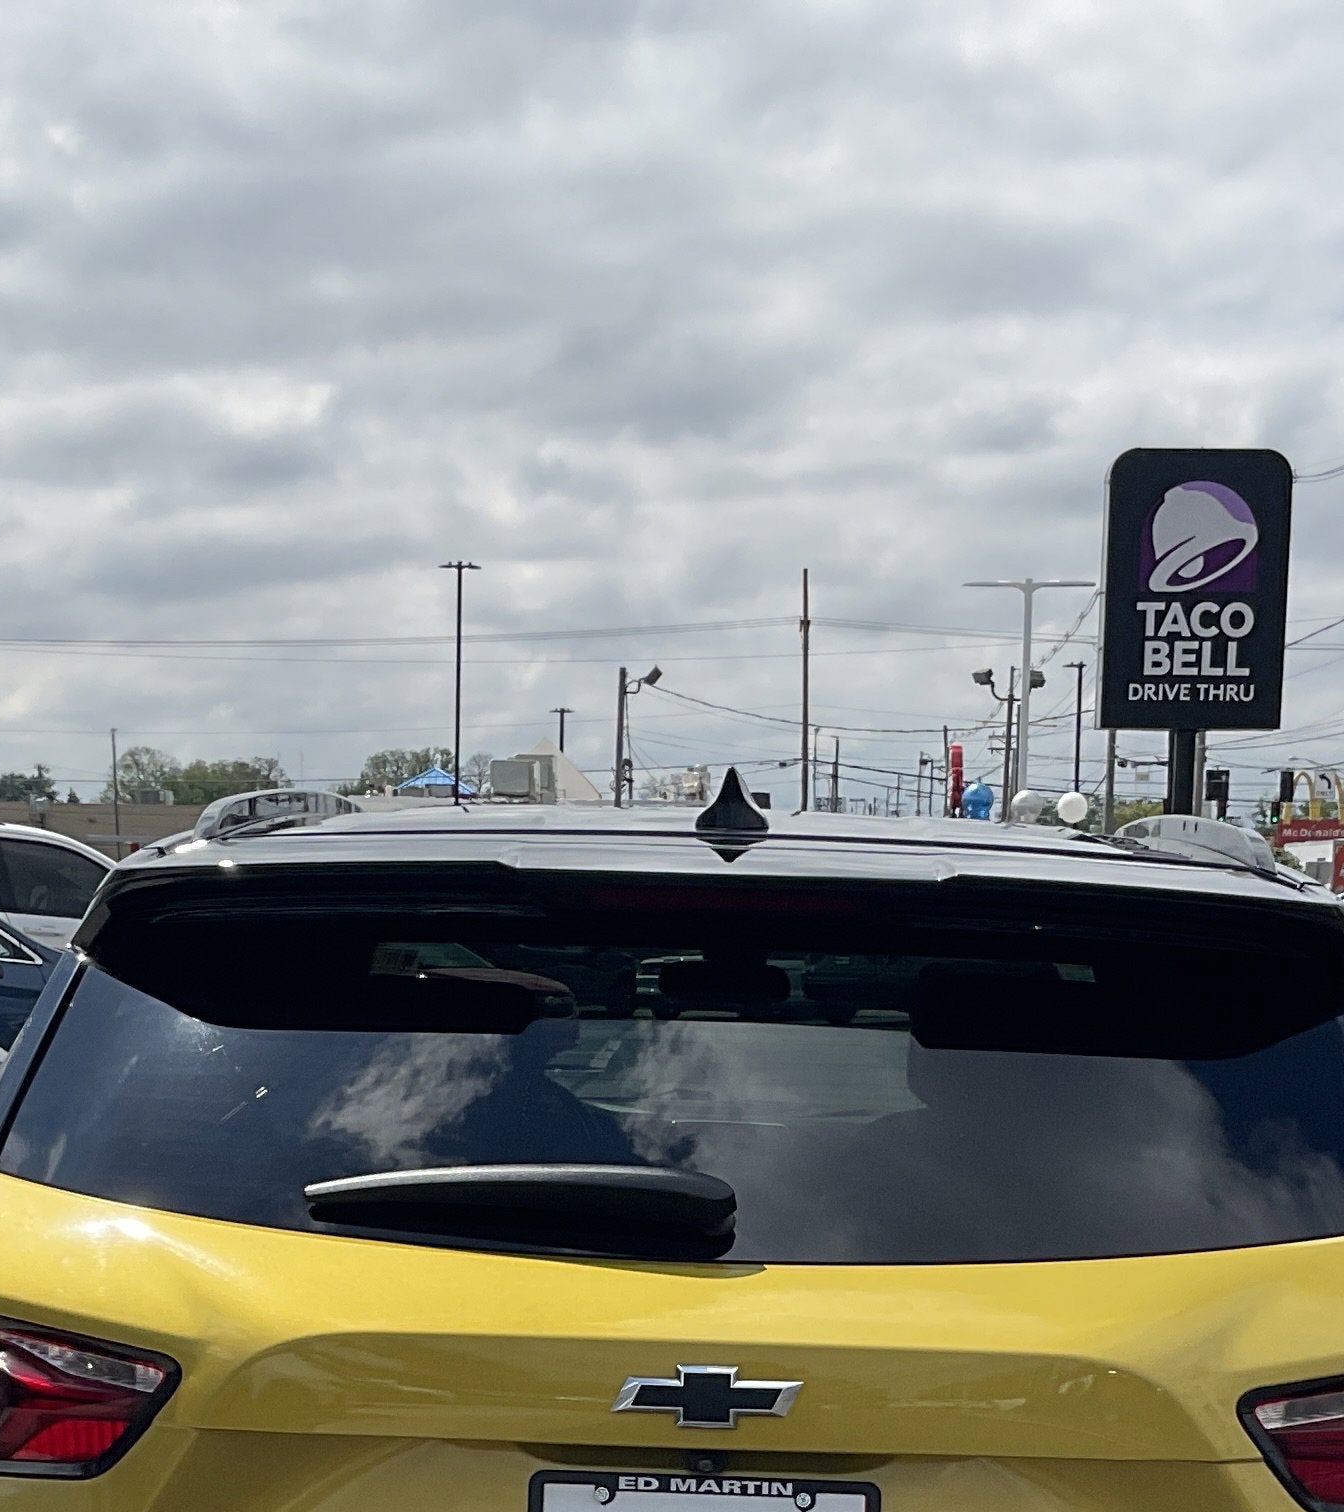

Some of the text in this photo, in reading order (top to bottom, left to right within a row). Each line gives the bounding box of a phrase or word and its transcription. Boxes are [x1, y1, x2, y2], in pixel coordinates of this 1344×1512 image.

[1136, 601, 1255, 638] TACO
[1143, 640, 1251, 677] BELL
[1128, 683, 1255, 702] DRIVE THRU
[618, 1476, 794, 1496] ED MARTIN
